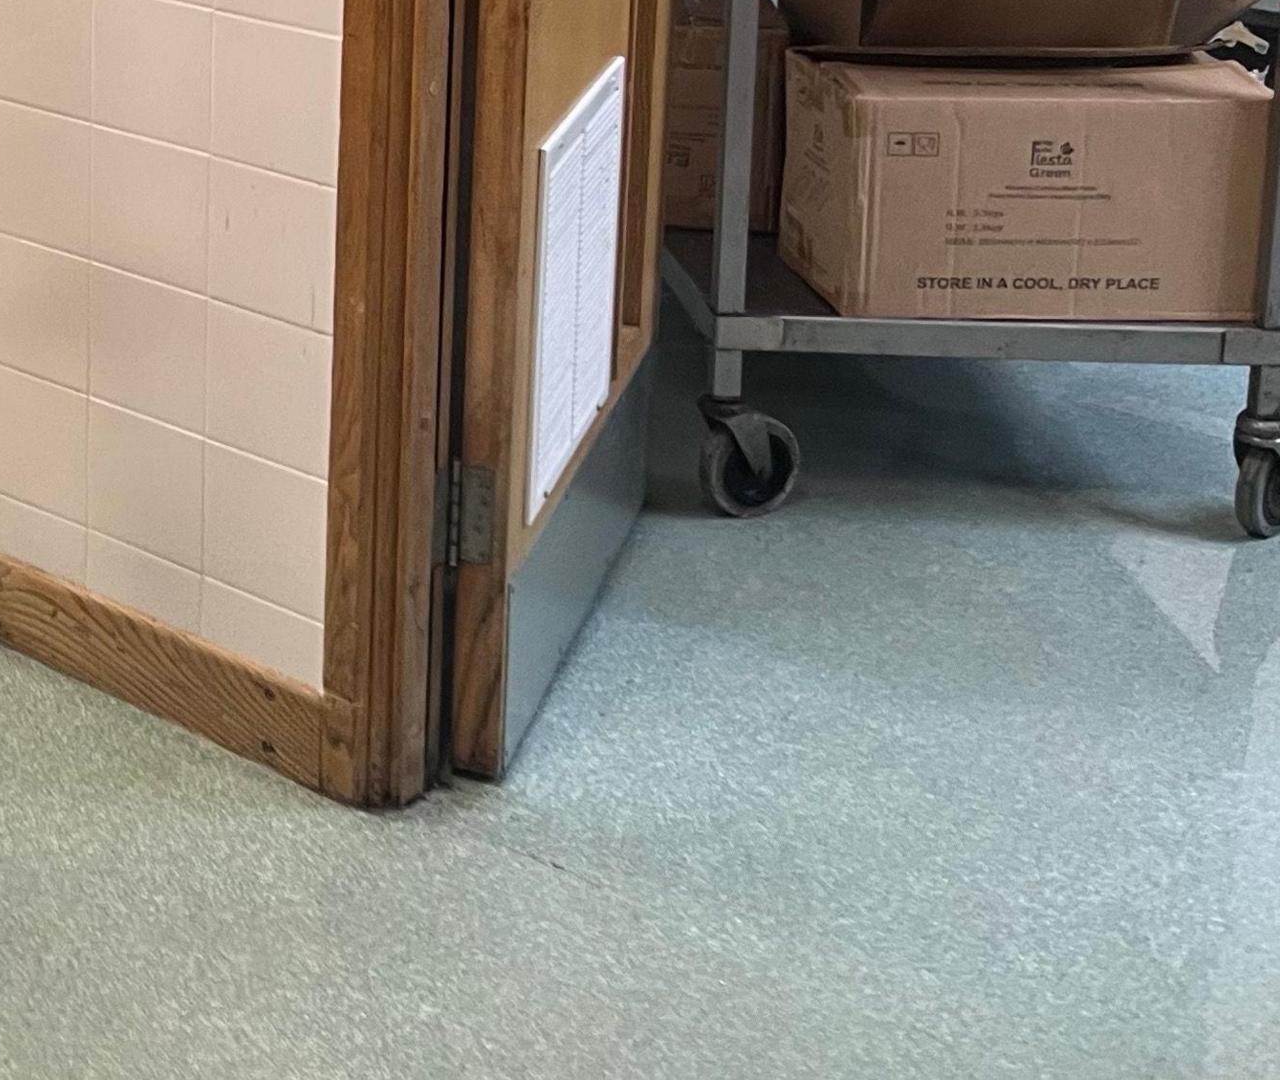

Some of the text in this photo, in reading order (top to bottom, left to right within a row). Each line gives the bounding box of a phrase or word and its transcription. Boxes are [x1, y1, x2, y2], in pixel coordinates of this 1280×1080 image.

[1030, 140, 1073, 166] Fiesta
[1029, 167, 1071, 178] Green
[917, 277, 1160, 291] STORE IN A COOL, DRY PLACE
